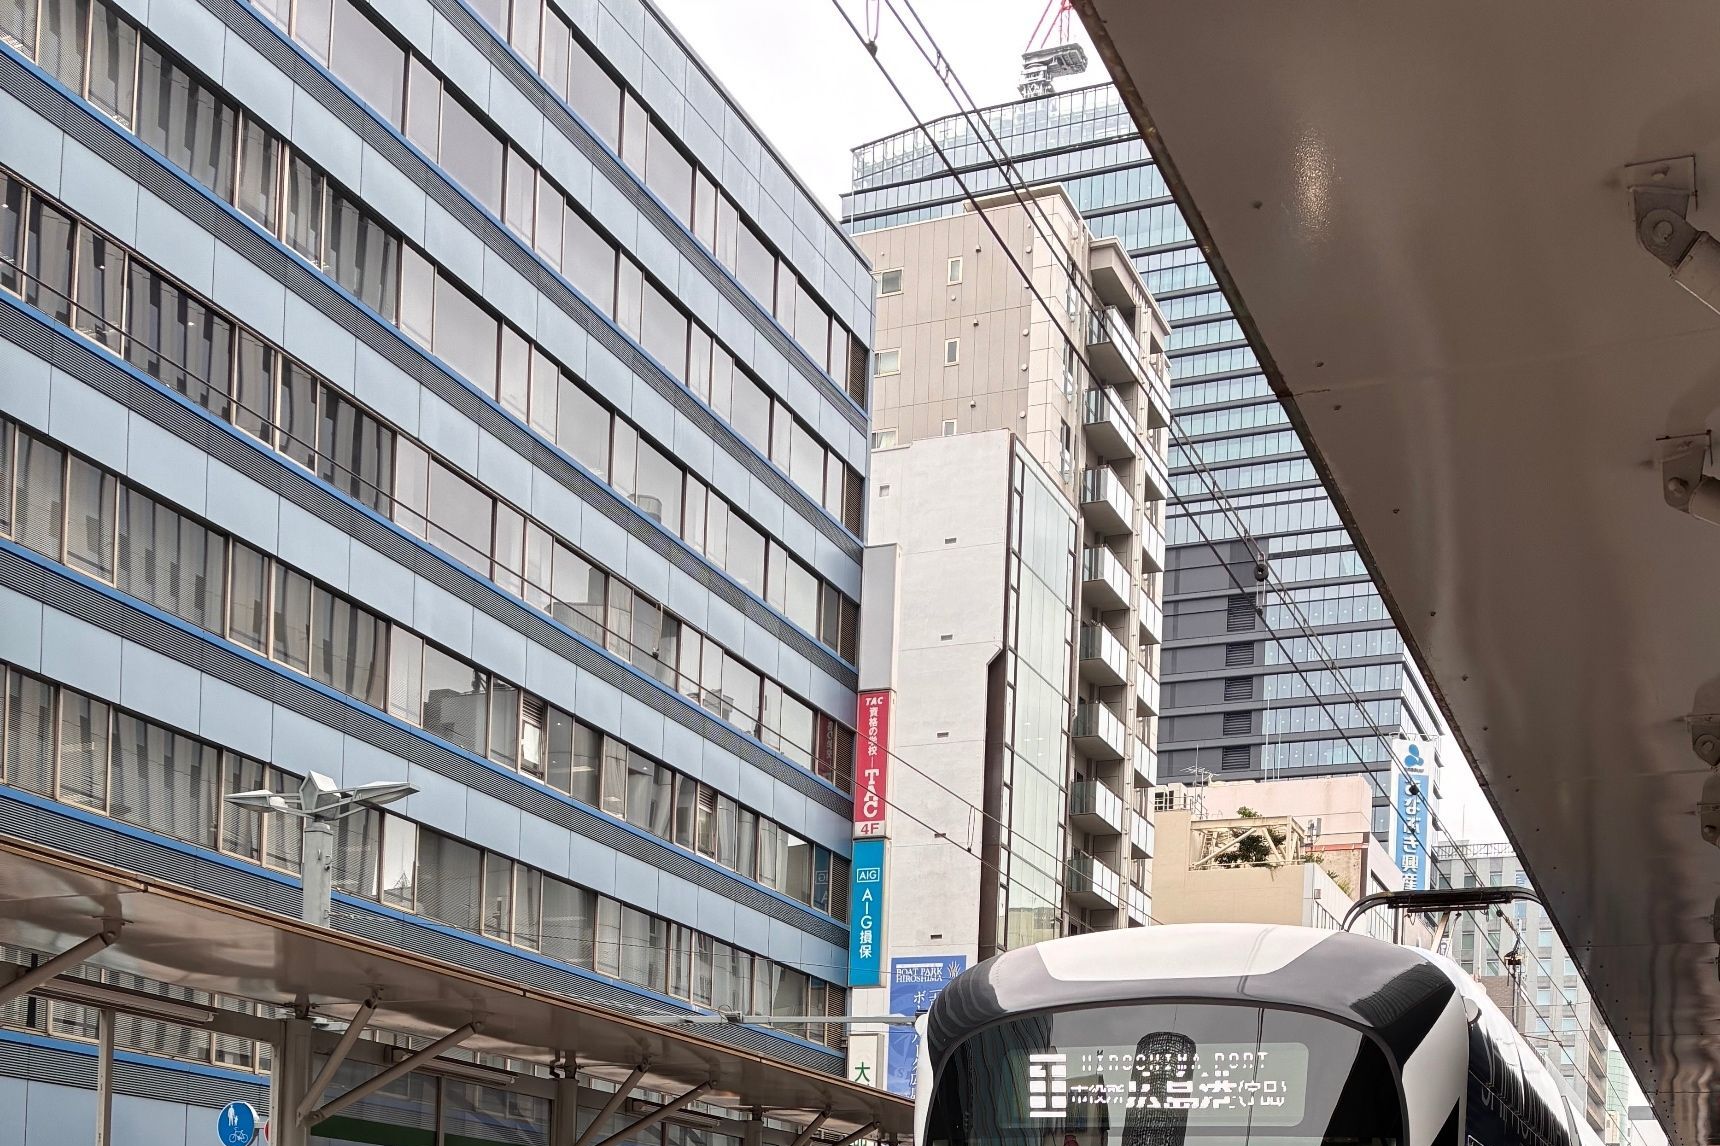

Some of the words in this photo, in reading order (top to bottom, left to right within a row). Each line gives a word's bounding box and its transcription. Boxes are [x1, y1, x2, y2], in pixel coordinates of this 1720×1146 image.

[865, 696, 883, 706] TAC
[867, 706, 878, 756] 資格の学校
[863, 768, 880, 818] TAC
[860, 822, 880, 835] 4F
[858, 870, 877, 880] AIG
[859, 887, 873, 959] AIG損保
[896, 967, 918, 975] BOAT
[921, 966, 943, 975] PARK
[896, 974, 943, 983] HIROSHIMA
[855, 1061, 871, 1082] 大
